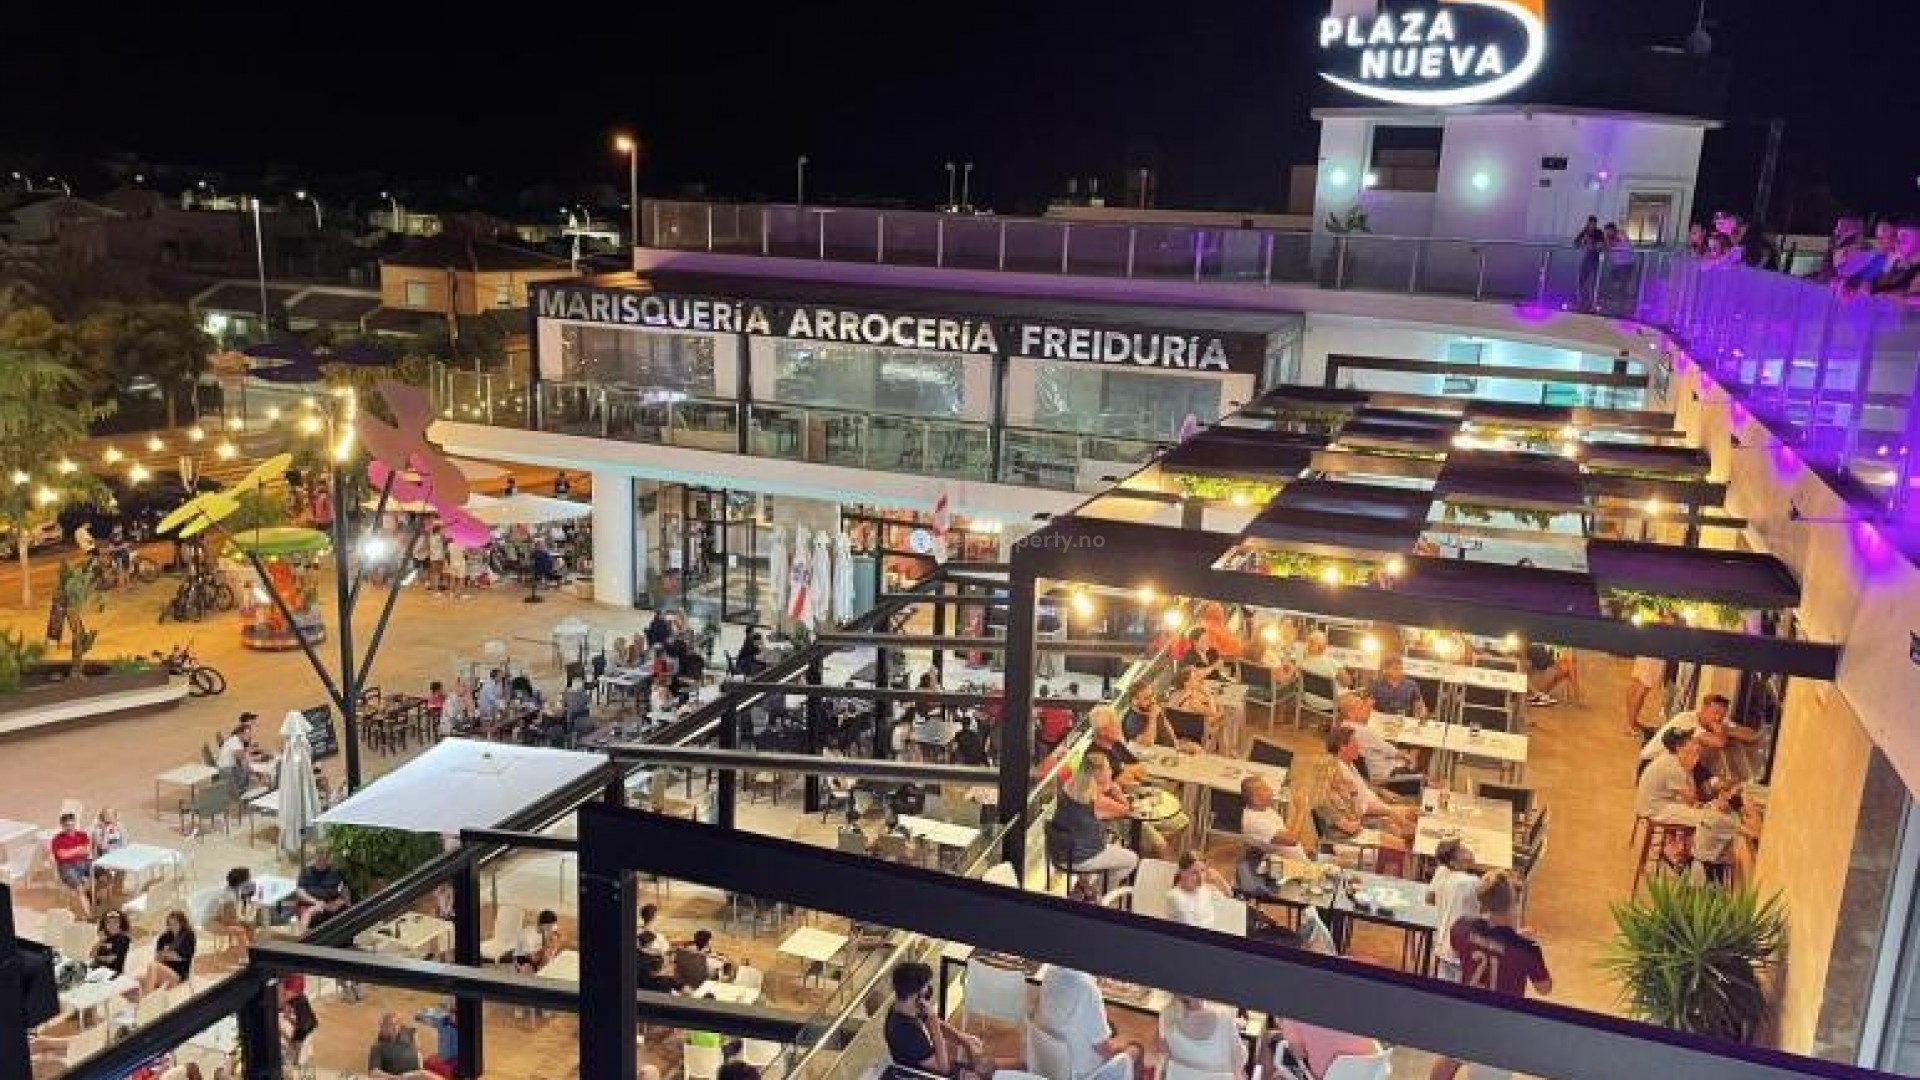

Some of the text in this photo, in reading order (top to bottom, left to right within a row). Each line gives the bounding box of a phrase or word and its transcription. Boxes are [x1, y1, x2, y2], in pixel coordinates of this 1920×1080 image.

[1320, 9, 1455, 48] PLAZA
[1360, 43, 1503, 79] NUEVA
[1469, 950, 1498, 991] 21
